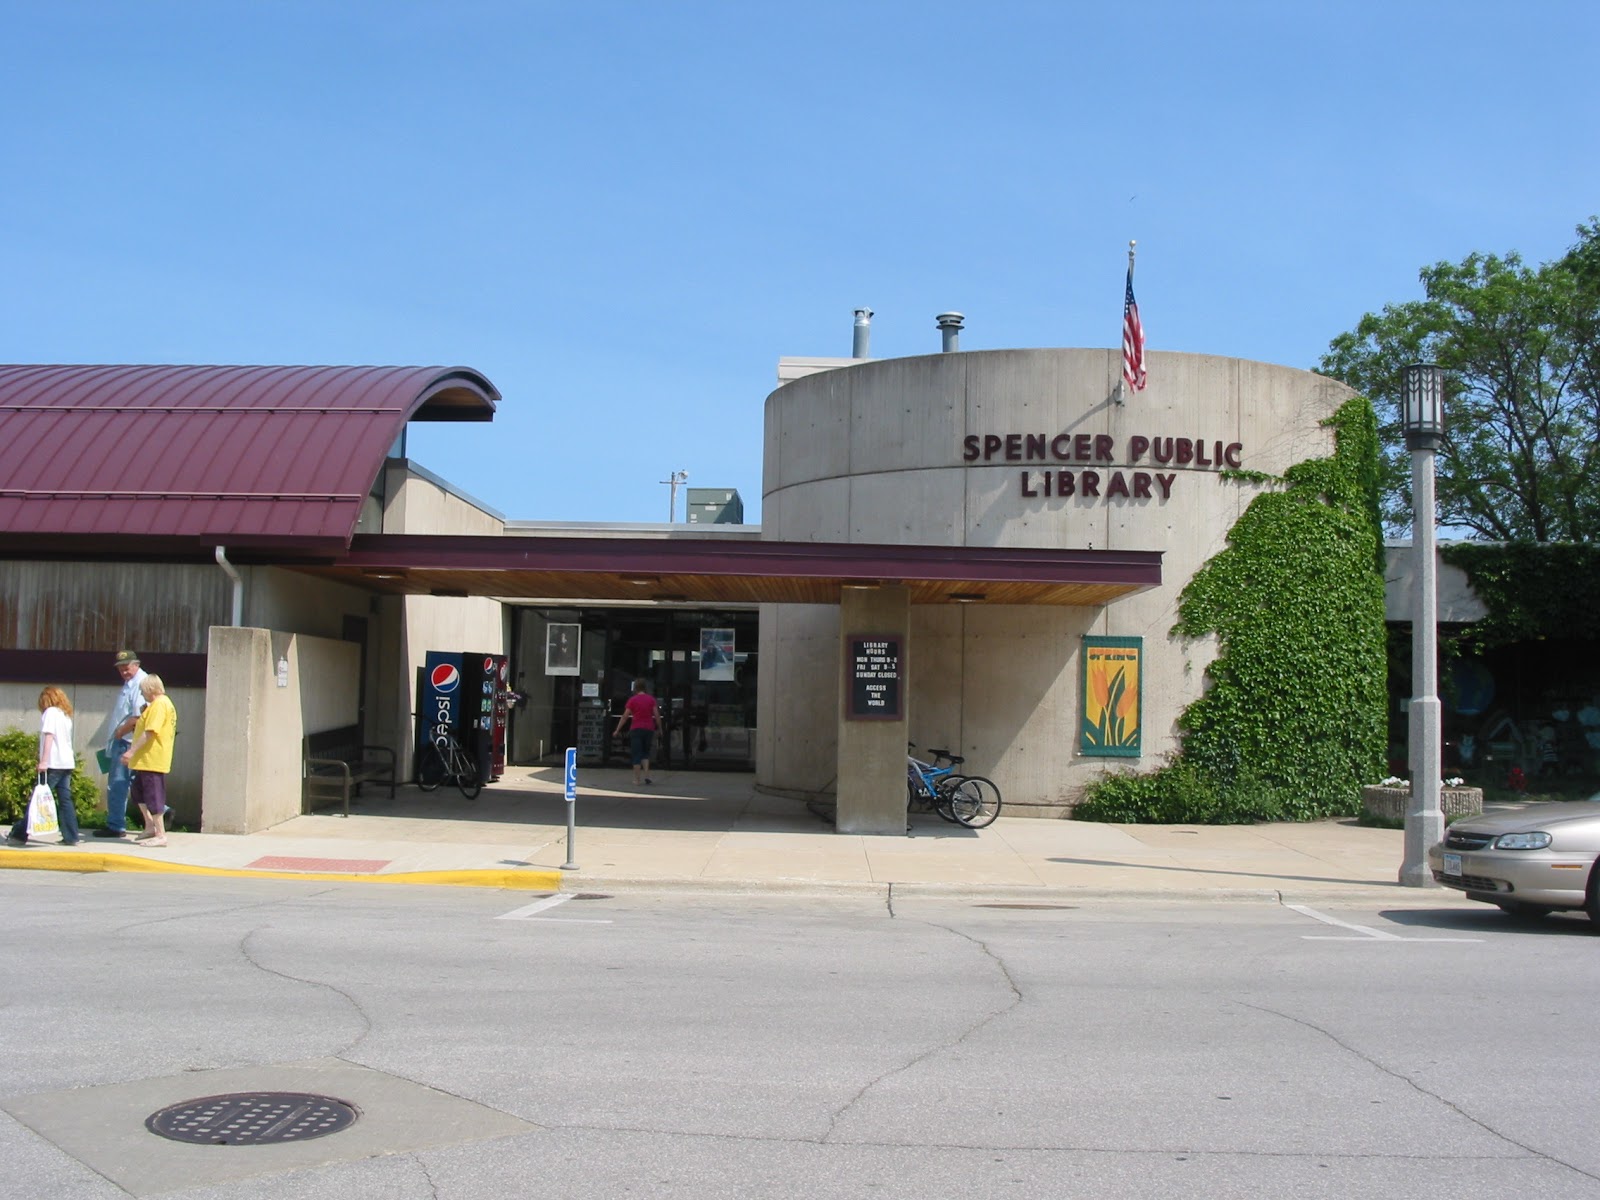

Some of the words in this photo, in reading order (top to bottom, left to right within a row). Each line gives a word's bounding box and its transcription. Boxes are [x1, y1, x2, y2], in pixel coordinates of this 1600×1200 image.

[963, 433, 1114, 461] SPENCER
[1130, 435, 1243, 468] PUBLIC
[1021, 471, 1176, 499] LIBRARY
